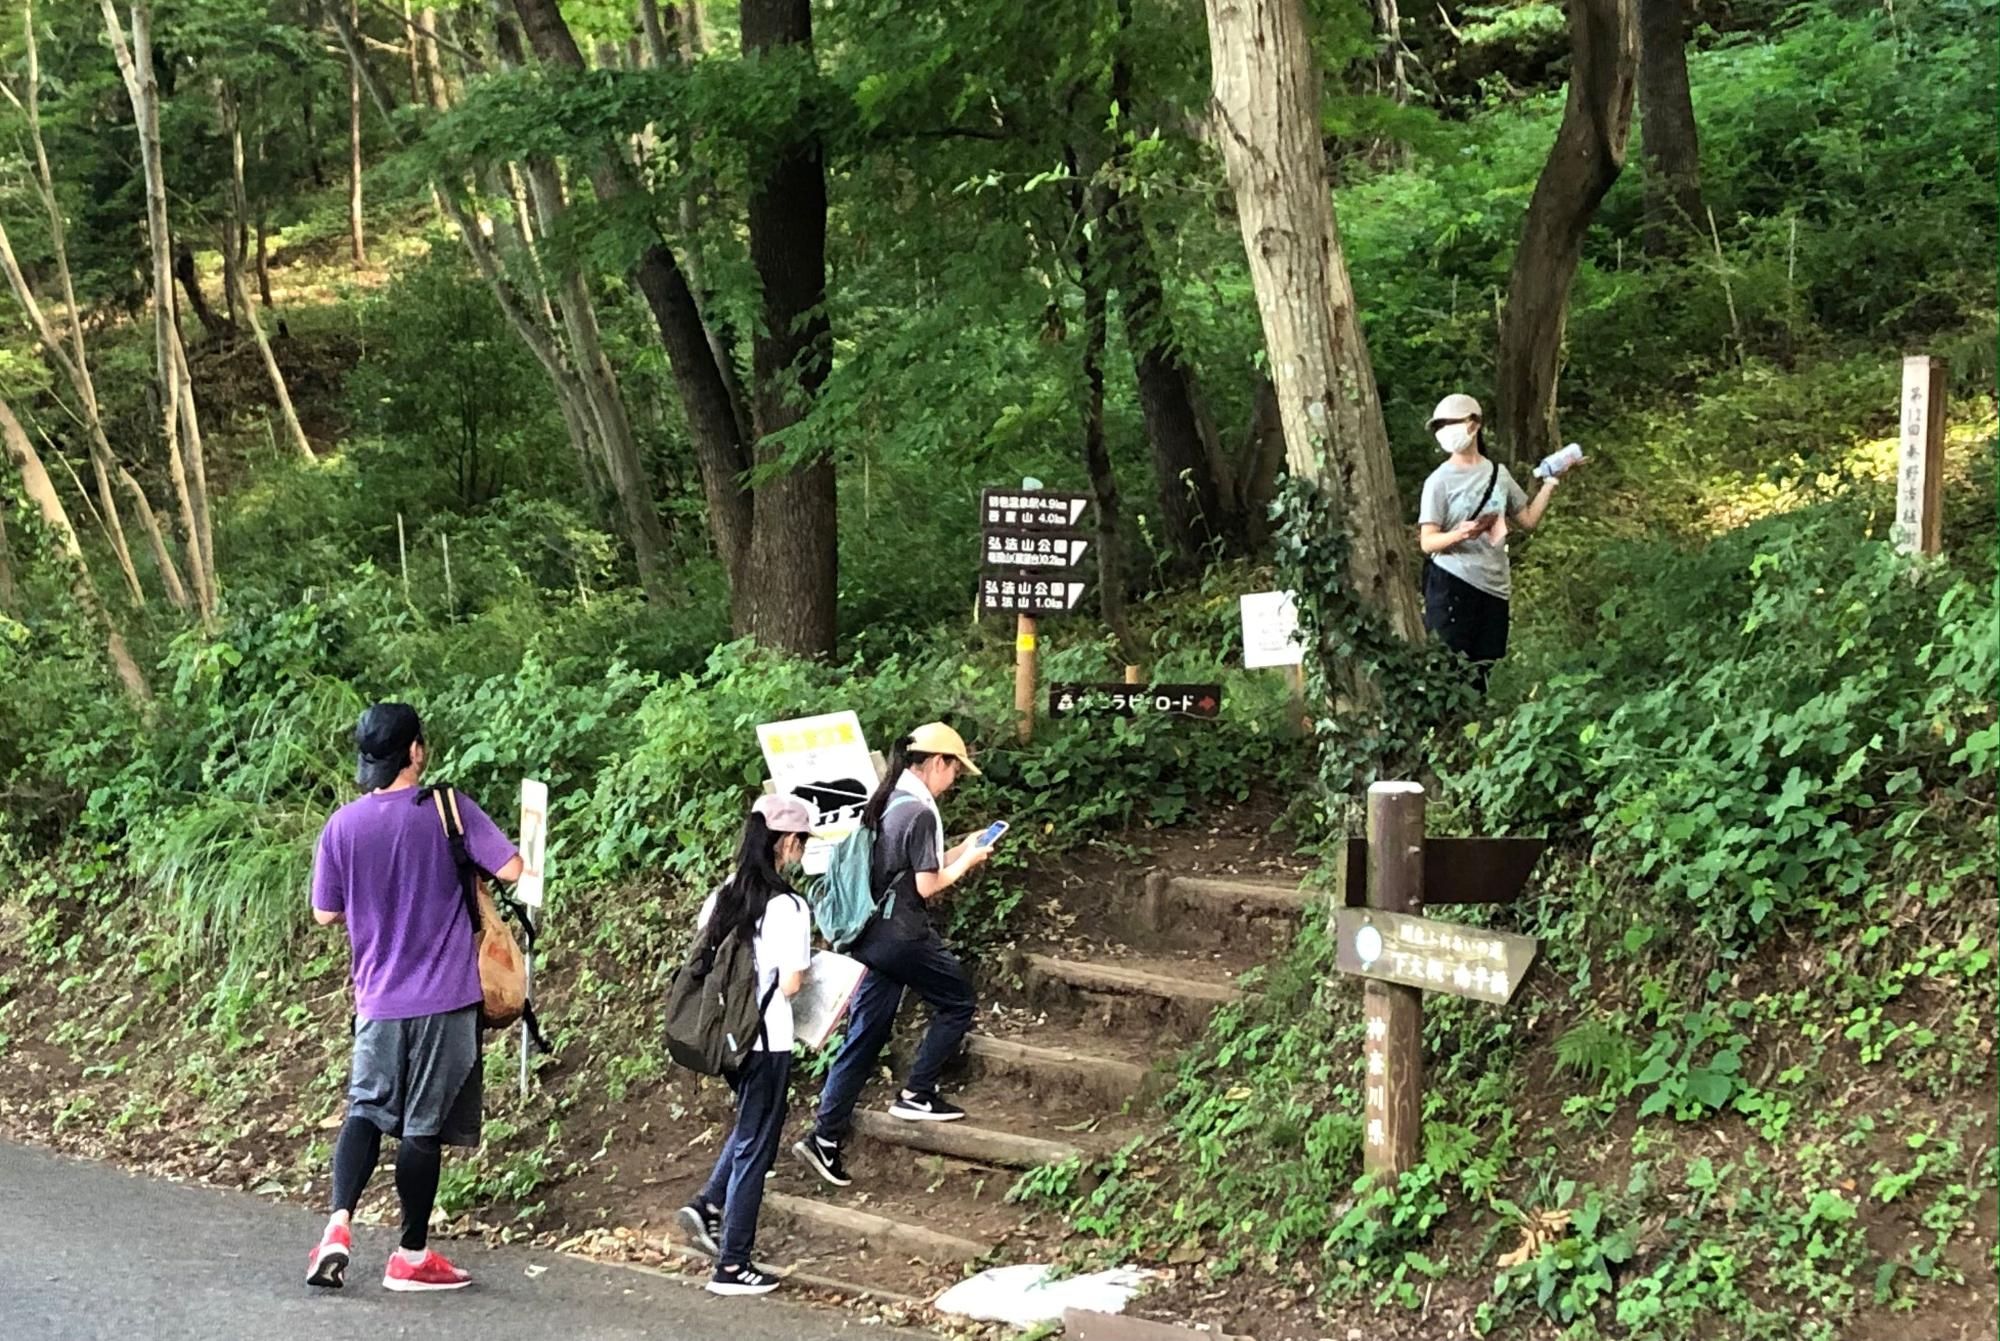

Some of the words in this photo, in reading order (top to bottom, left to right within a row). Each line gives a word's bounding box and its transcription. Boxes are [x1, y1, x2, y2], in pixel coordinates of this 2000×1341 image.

[1038, 513, 1066, 524] 4.0km
[988, 536, 1067, 553] 弘法山公園
[985, 580, 1064, 596] 弘法山公園
[985, 595, 1029, 608] 弘法山
[1035, 597, 1063, 609] 1.0km
